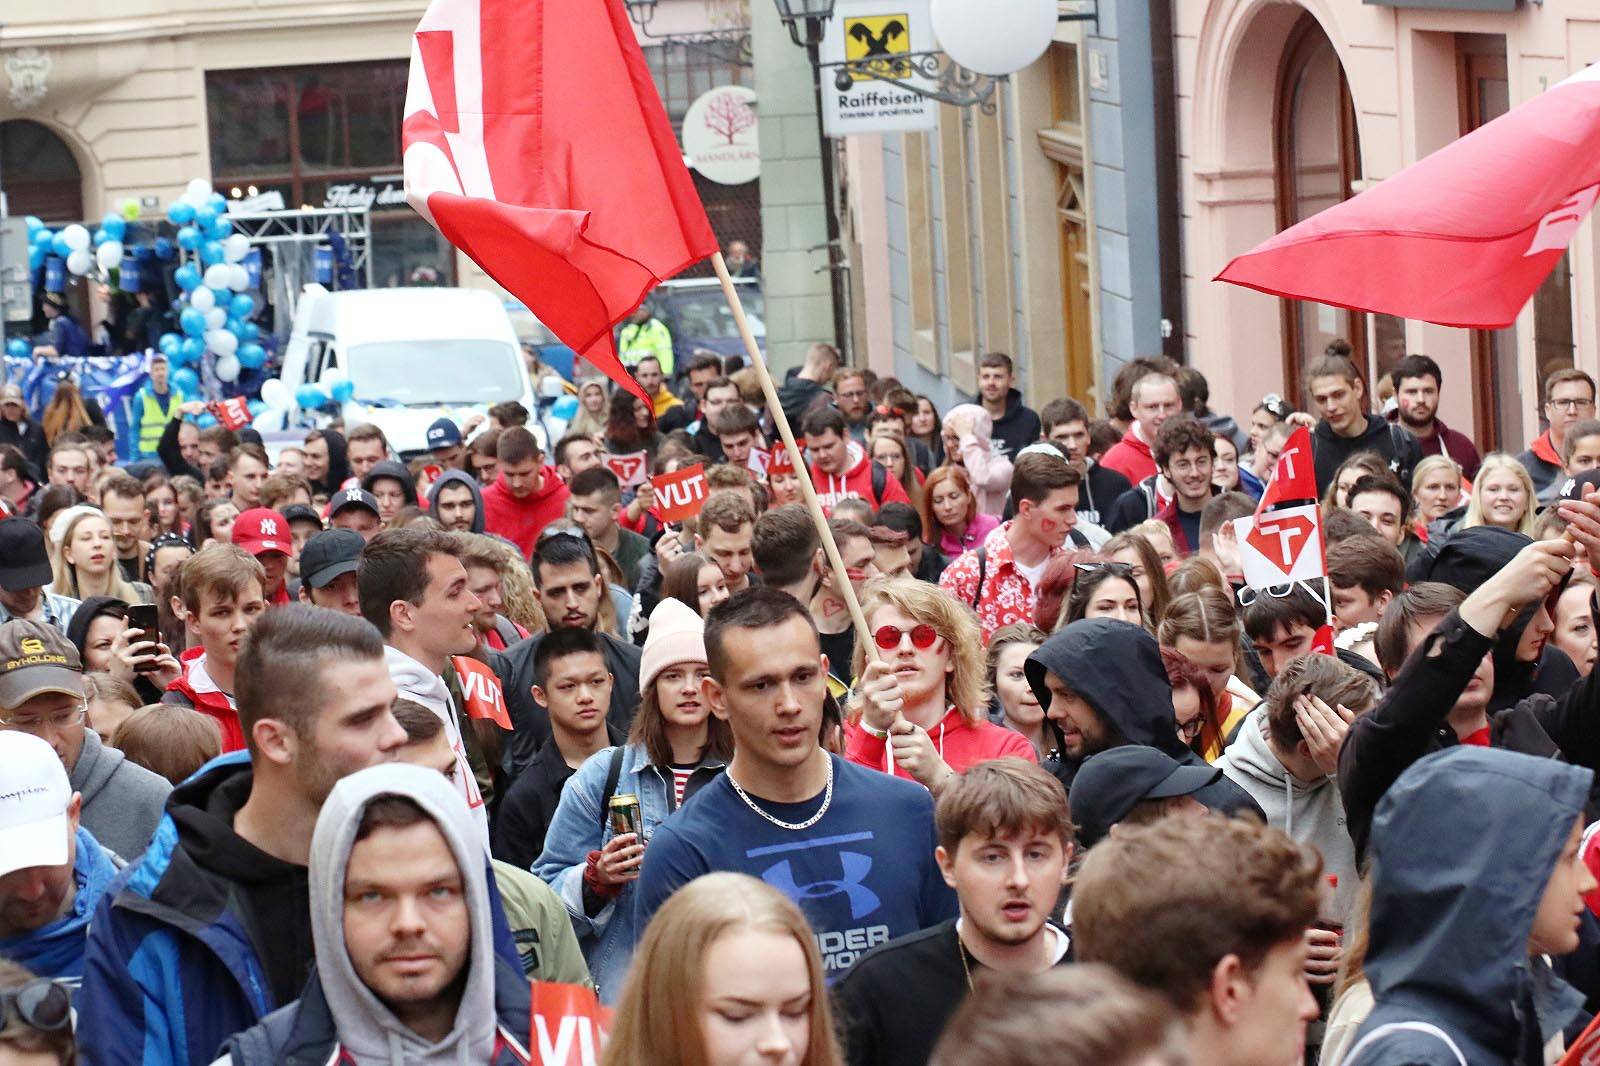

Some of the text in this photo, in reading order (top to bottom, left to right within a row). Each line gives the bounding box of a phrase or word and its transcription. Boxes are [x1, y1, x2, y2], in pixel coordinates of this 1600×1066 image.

[838, 91, 923, 108] Raiffeisen
[653, 474, 704, 509] VUT
[456, 671, 502, 713] VUT
